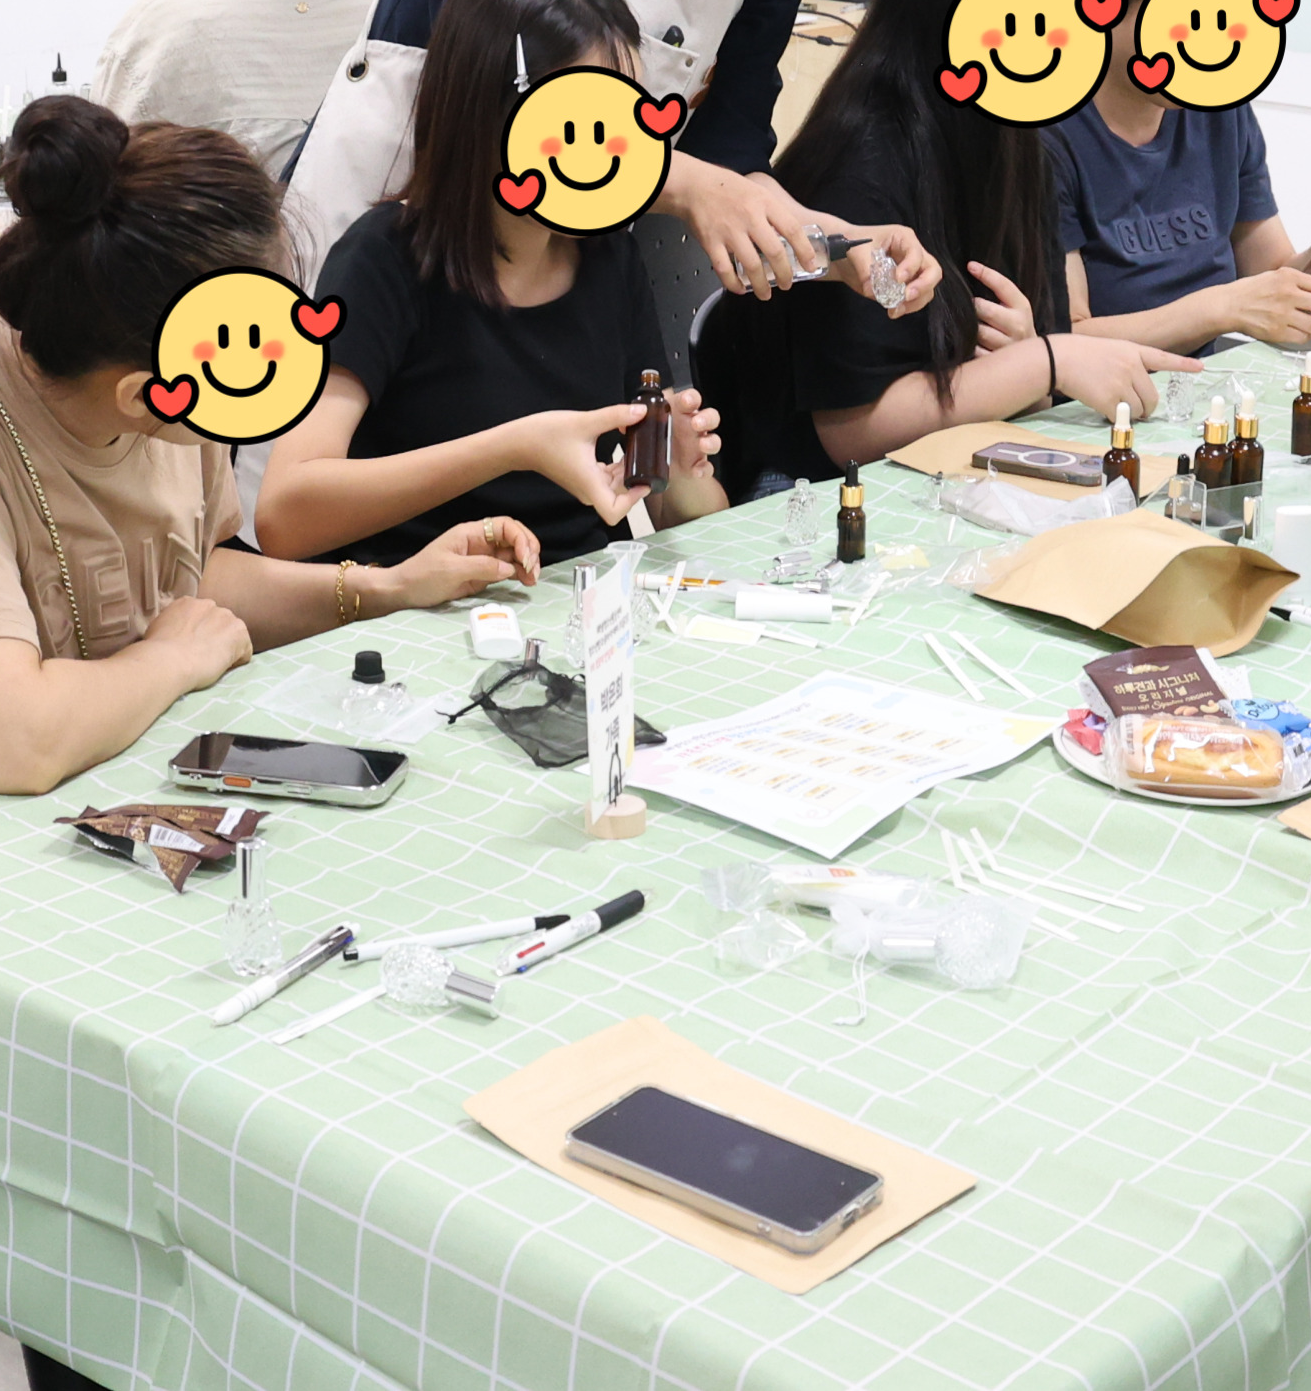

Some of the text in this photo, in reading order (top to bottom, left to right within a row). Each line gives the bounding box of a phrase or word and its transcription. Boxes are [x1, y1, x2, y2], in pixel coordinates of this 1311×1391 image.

[1113, 204, 1211, 255] GUESS
[1113, 672, 1201, 695] 하루견과 시그니처
